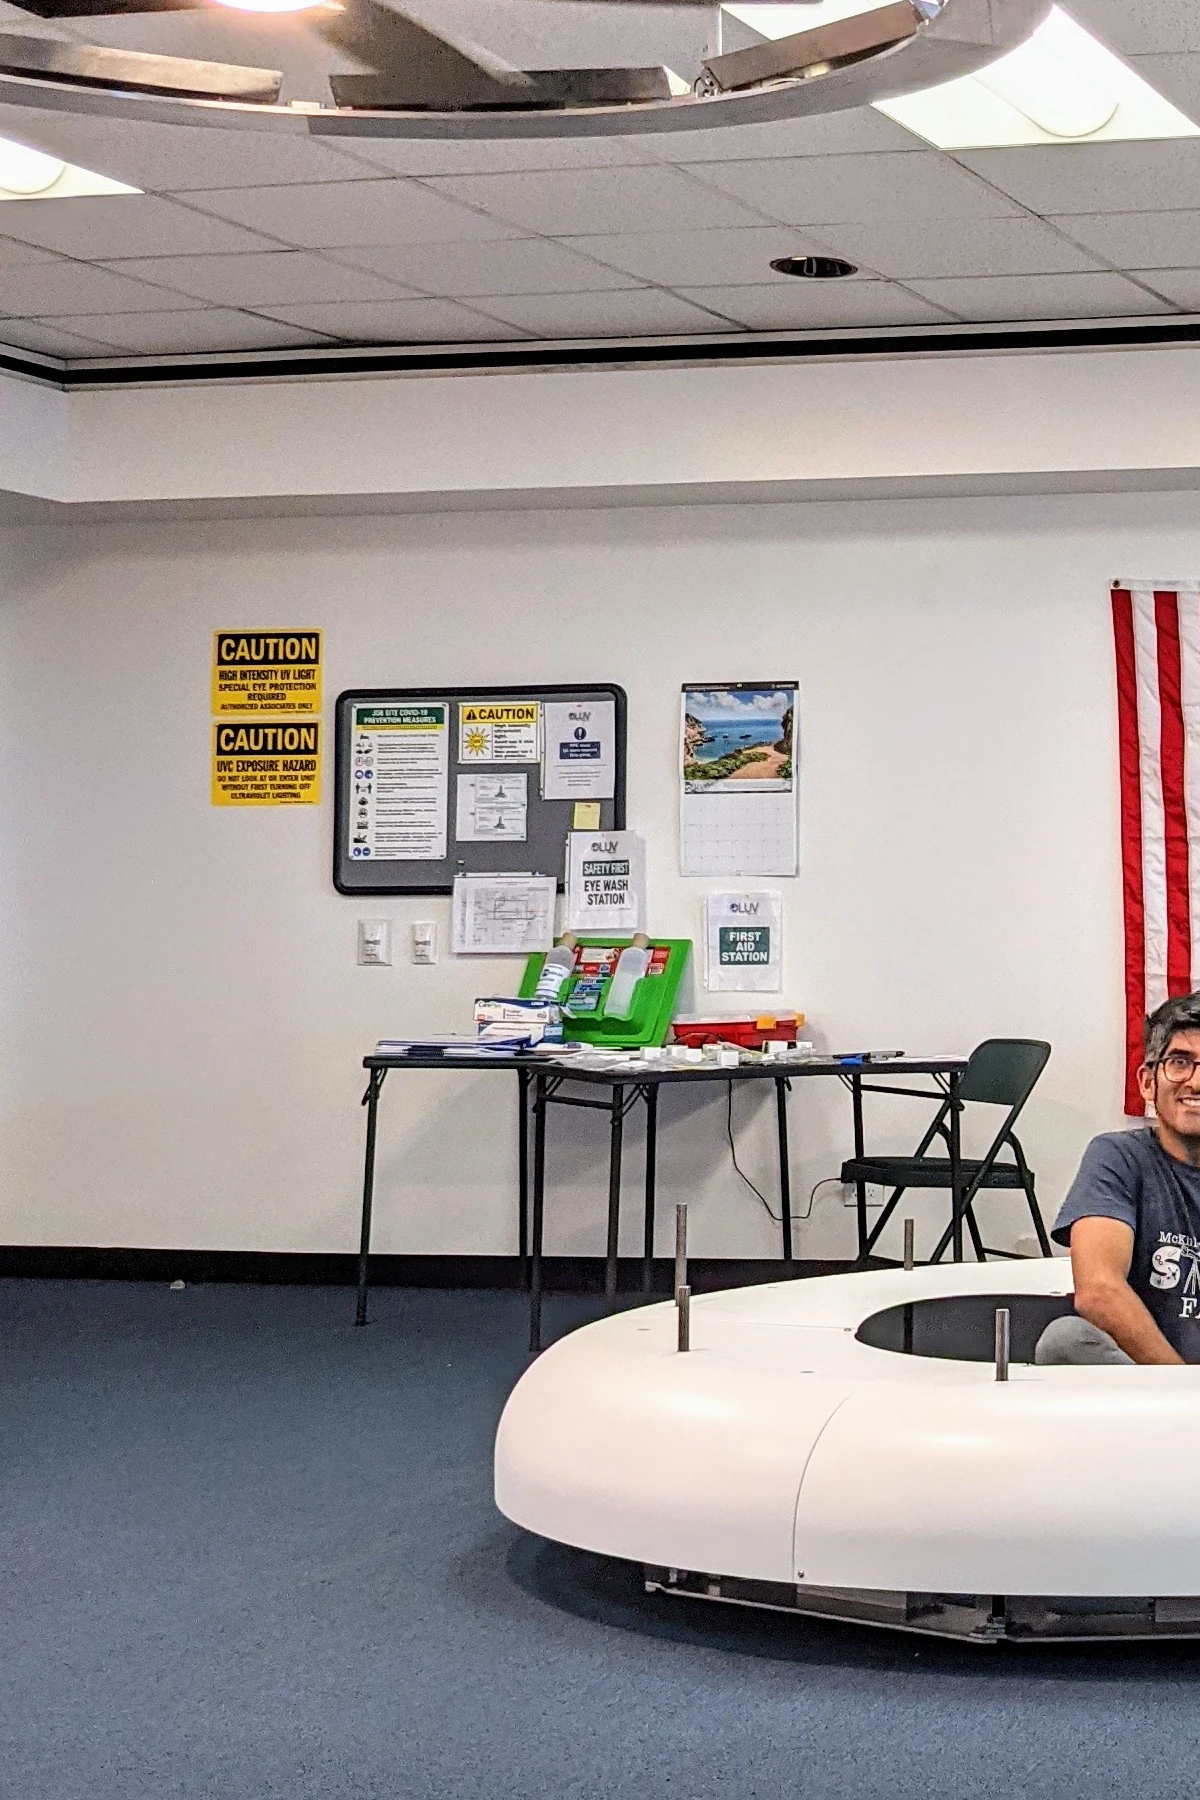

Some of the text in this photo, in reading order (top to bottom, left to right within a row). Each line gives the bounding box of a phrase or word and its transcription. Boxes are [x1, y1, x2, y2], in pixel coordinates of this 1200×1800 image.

[221, 638, 316, 660] CAUTION
[219, 669, 316, 680] HIGH INTENSITY UV LIGHT
[219, 682, 316, 691] SPECIAL EYE PROTECTION
[478, 708, 535, 720] CAUTION
[220, 728, 315, 751] CAUTION
[217, 759, 317, 772] UVC EXPOSURE HAZARD
[584, 862, 629, 874] SAFETY FIRST
[584, 879, 629, 891] EYE WASH
[587, 893, 625, 905] STATION
[729, 932, 762, 942] FIRST
[736, 942, 755, 951] AID
[722, 952, 768, 962] STATION
